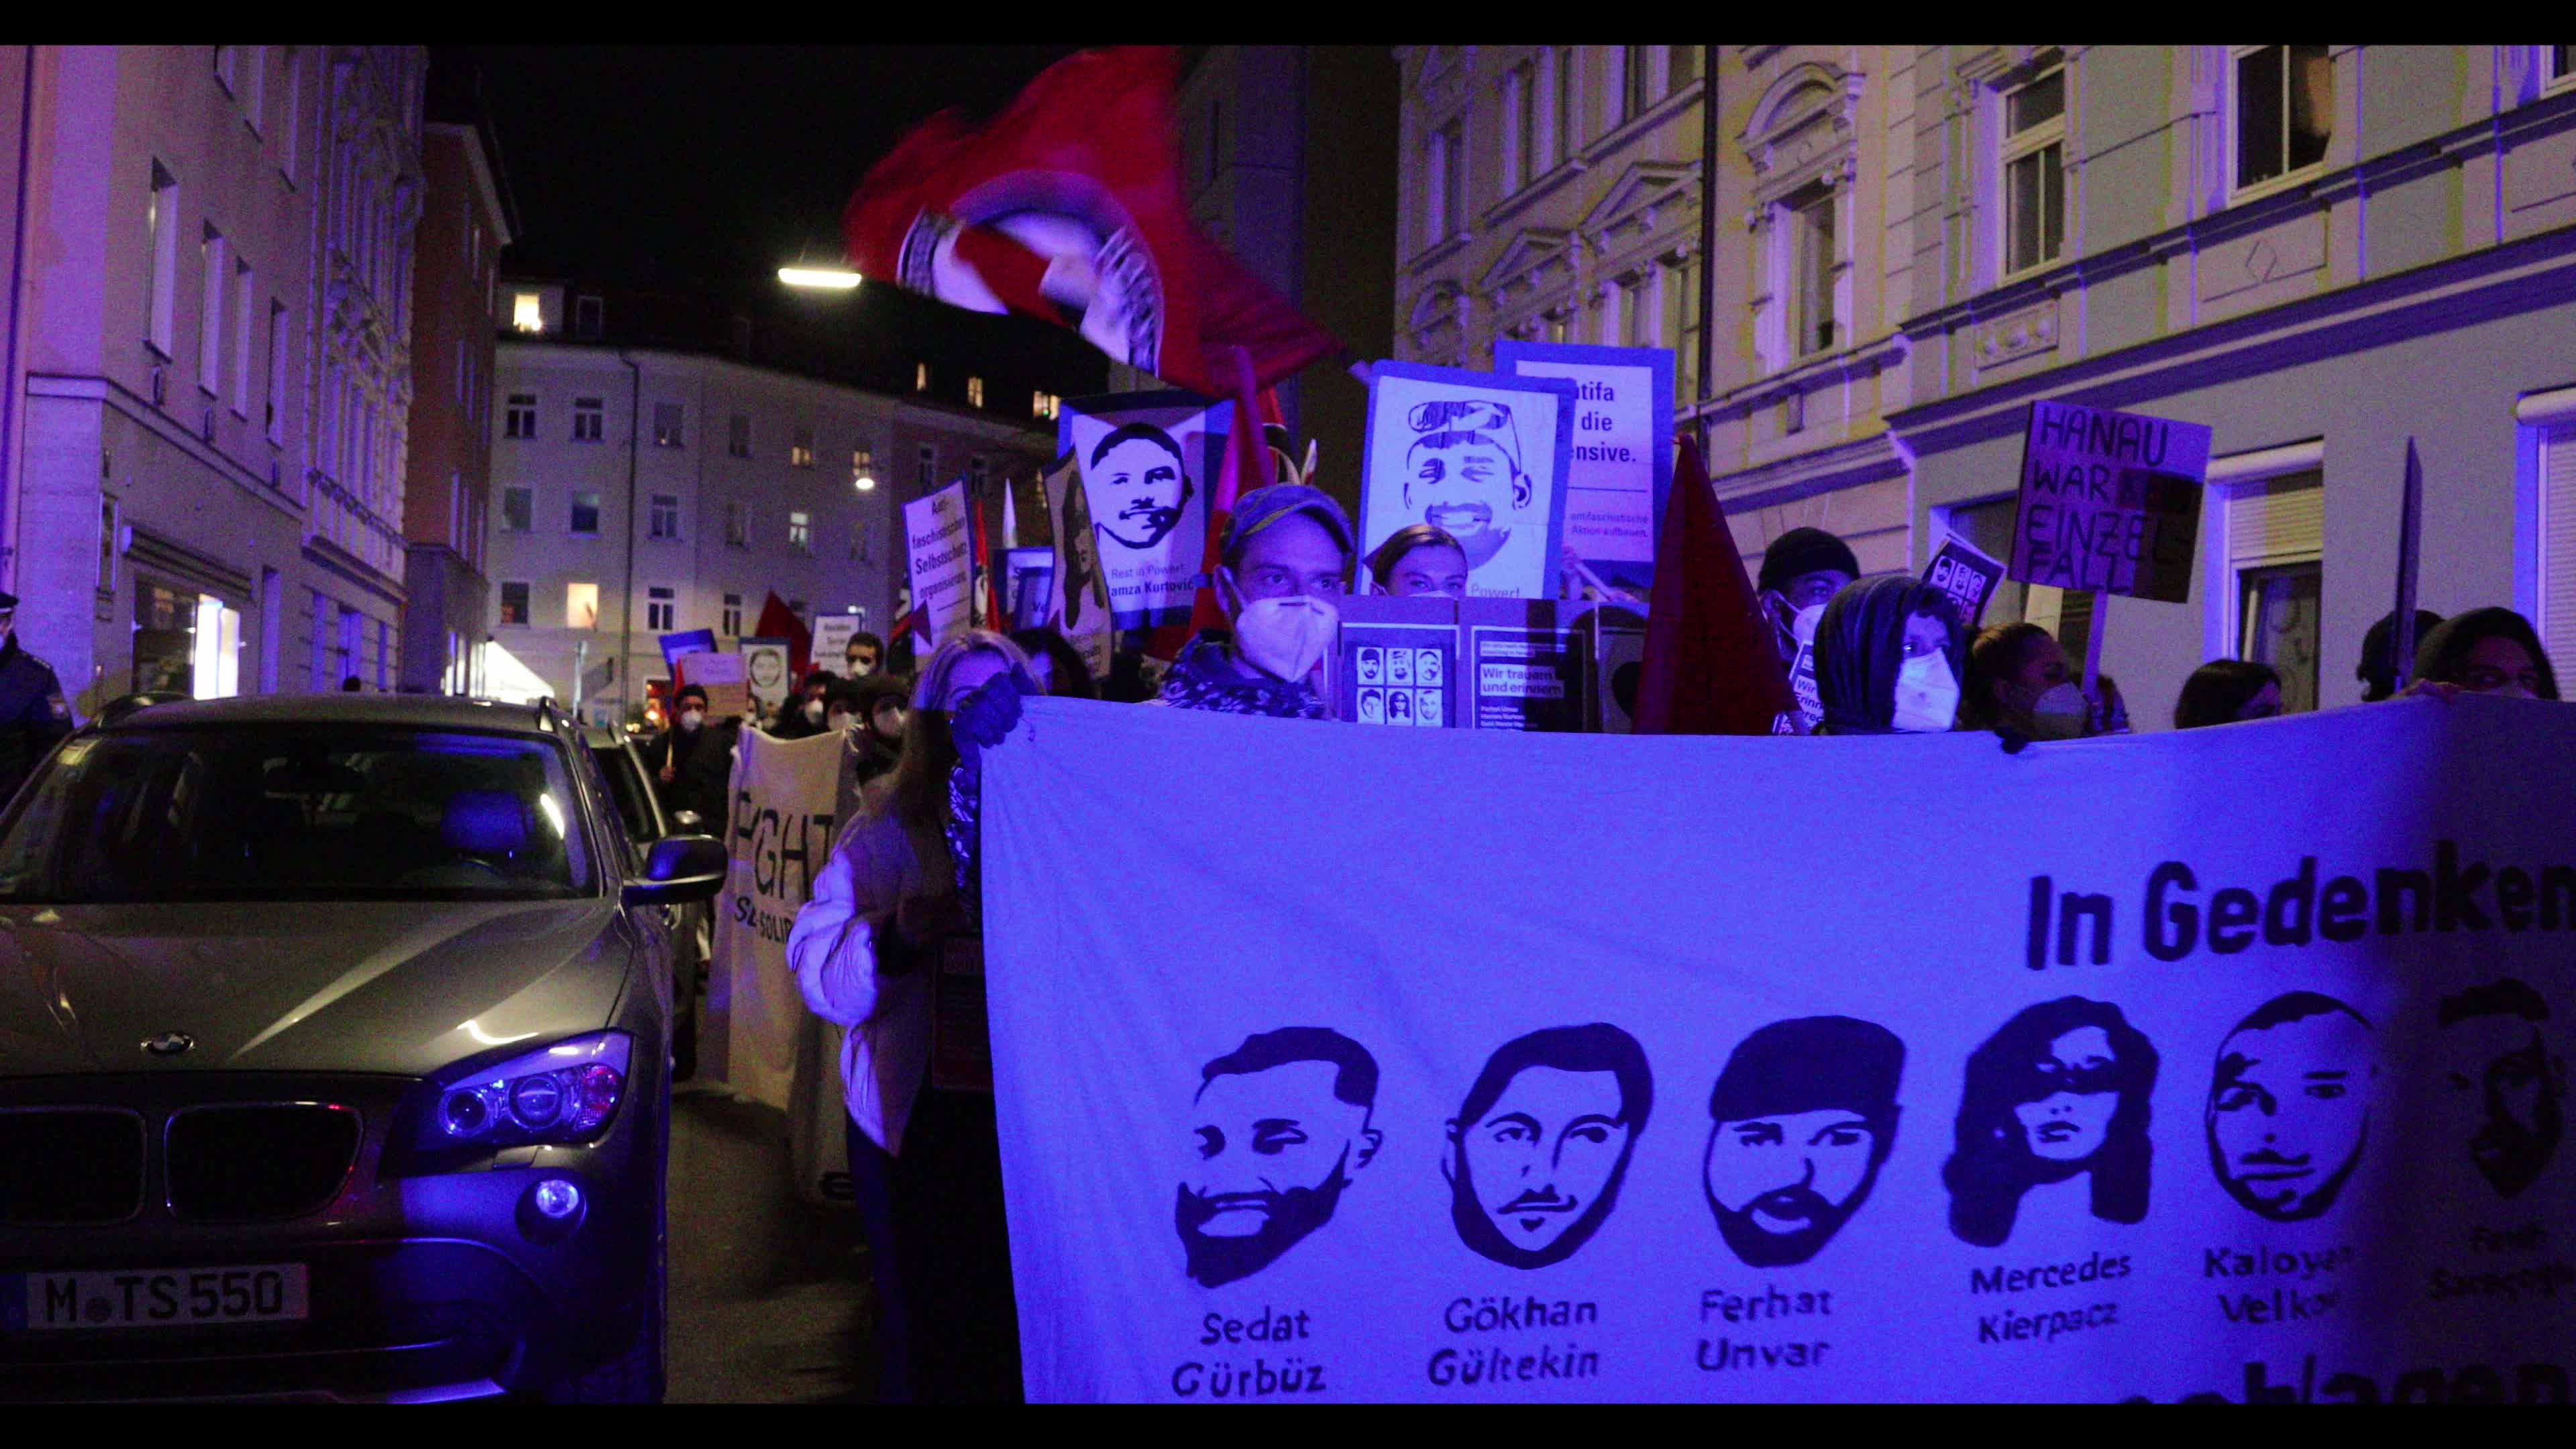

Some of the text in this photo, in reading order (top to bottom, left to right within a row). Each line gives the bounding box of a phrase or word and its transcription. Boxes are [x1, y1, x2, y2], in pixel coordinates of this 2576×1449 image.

[1573, 381, 1615, 402] tifa
[1581, 411, 1613, 431] die
[2040, 405, 2168, 467] HANAU
[1569, 441, 1636, 462] nsive.
[2033, 460, 2110, 501] WAR
[1111, 568, 1134, 580] Rest
[2026, 545, 2132, 592] FALL
[1106, 584, 1141, 596] amza
[1483, 667, 1503, 678] Wir
[1483, 682, 1507, 693] und
[1797, 680, 1816, 694] Wir
[2025, 838, 2576, 971] In Gedenken
[1971, 1251, 2132, 1295] Mercedes
[45, 1279, 77, 1322] M
[1444, 1296, 1599, 1334] Gökhan
[1699, 1284, 1832, 1323] Ferhat
[1200, 1305, 1310, 1344] Sedat
[1978, 1303, 2118, 1344] Kierpacz
[1171, 1356, 1326, 1398] Gürbüz
[1426, 1344, 1599, 1387] Gültekin
